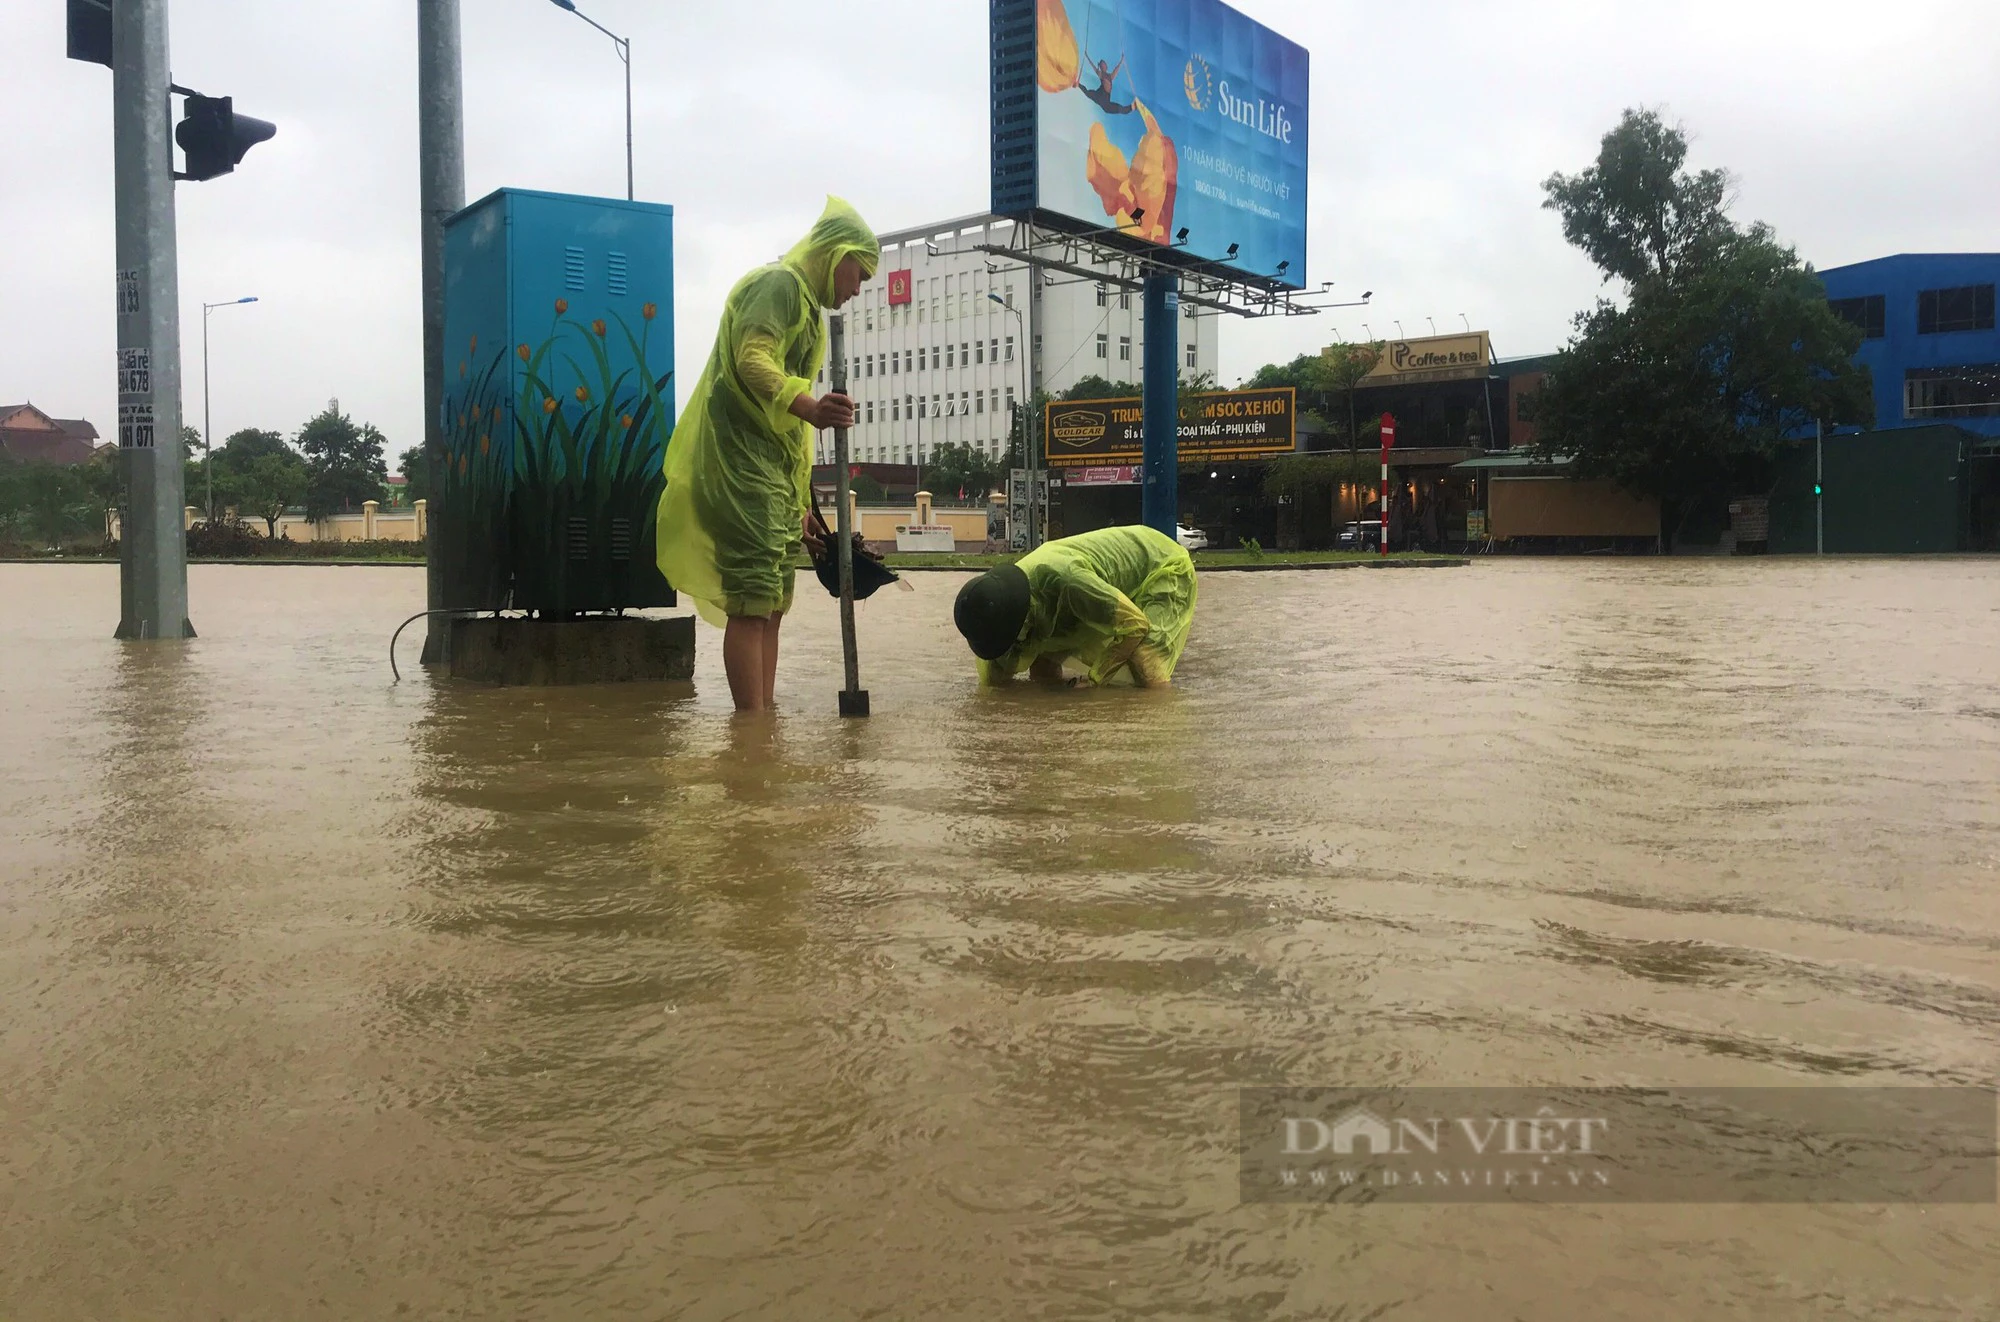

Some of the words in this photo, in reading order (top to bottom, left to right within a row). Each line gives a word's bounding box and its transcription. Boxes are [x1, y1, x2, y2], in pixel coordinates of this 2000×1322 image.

[1218, 80, 1255, 129] Sun
[1258, 98, 1292, 144] Life
[1183, 145, 1193, 161] 10
[1234, 166, 1247, 183] VỆ
[1274, 181, 1290, 200] VIỆT
[1408, 353, 1447, 367] Coffee
[1448, 352, 1457, 363] &
[1459, 351, 1478, 362] tea
[130, 370, 149, 393] 678
[1112, 408, 1143, 423] TRUN
[1216, 398, 1242, 417] SÓC
[1244, 400, 1262, 416] XE
[136, 425, 154, 447] 071
[1057, 427, 1101, 436] GOLDCAR
[1176, 424, 1198, 439] GOẠI
[1200, 420, 1220, 436] THẤT
[1226, 423, 1244, 437] PHỤ
[1245, 420, 1266, 436] KIỆN
